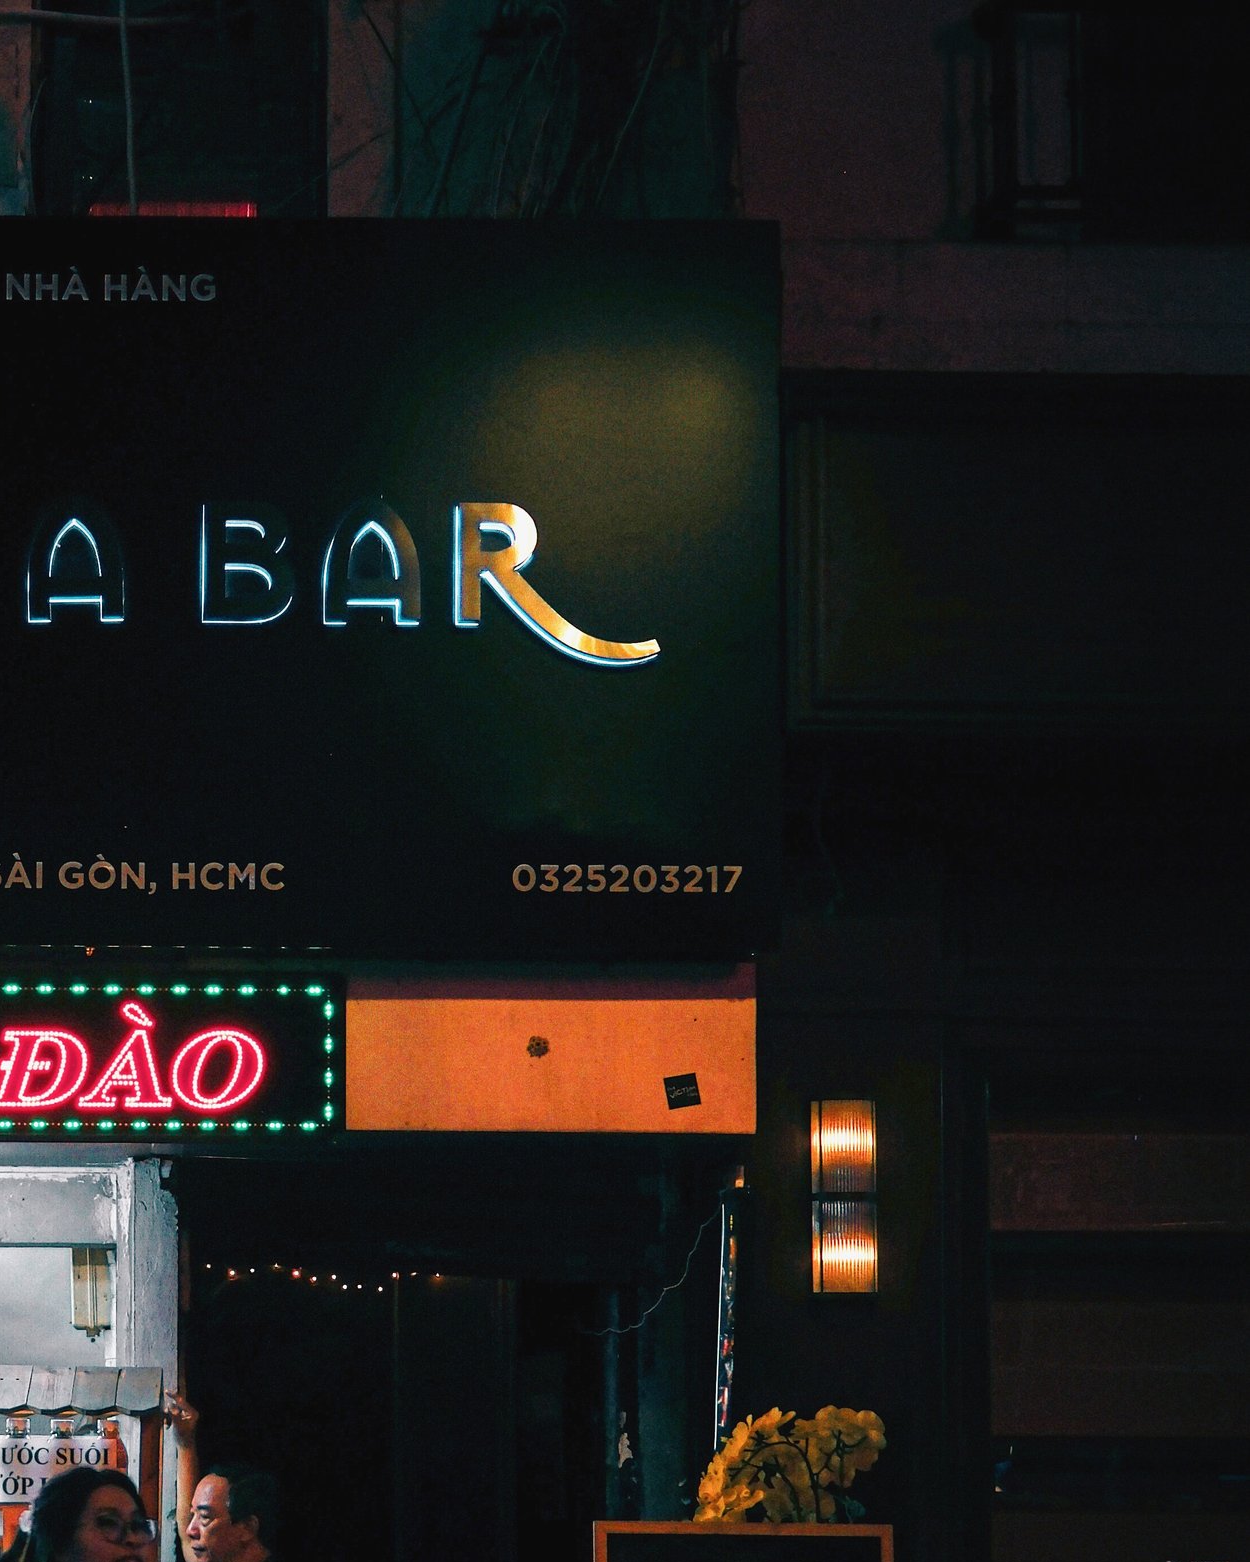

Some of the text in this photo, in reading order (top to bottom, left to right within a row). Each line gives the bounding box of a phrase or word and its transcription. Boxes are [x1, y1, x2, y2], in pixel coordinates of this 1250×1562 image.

[5, 265, 90, 301] NHÀ
[104, 265, 217, 302] HÀNG
[25, 502, 125, 625] A
[199, 500, 662, 668] BAR
[57, 853, 158, 895] GÒN,
[171, 861, 286, 891] HCMC
[511, 863, 743, 894] 0325203217
[56, 1443, 110, 1465] SUỐI
